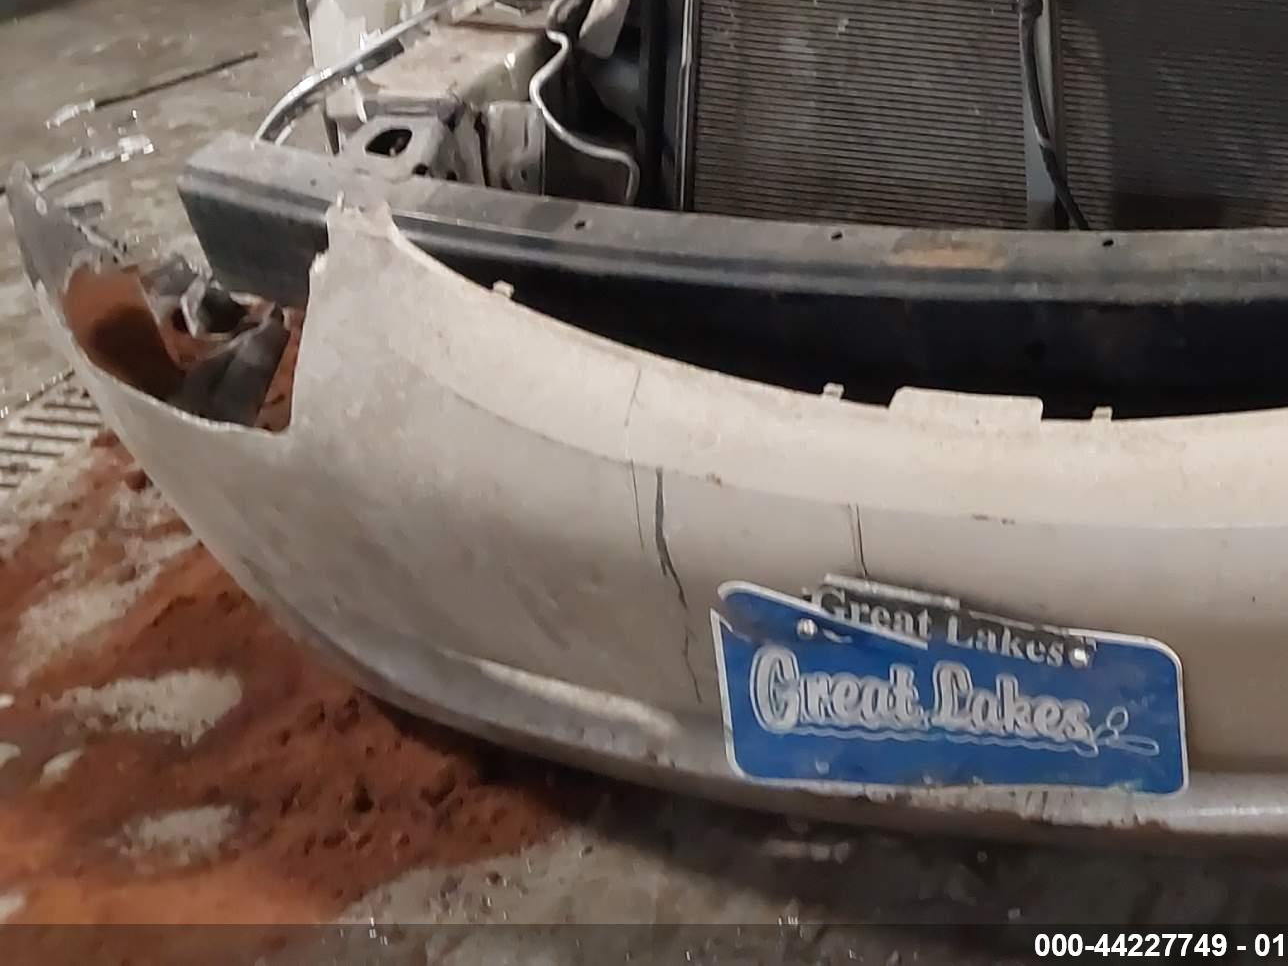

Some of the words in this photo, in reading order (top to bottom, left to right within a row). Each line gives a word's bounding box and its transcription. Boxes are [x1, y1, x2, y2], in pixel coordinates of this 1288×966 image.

[807, 584, 932, 640] Great
[946, 614, 1065, 667] Lakes
[751, 645, 930, 733] Great
[932, 660, 1095, 748] Lakes
